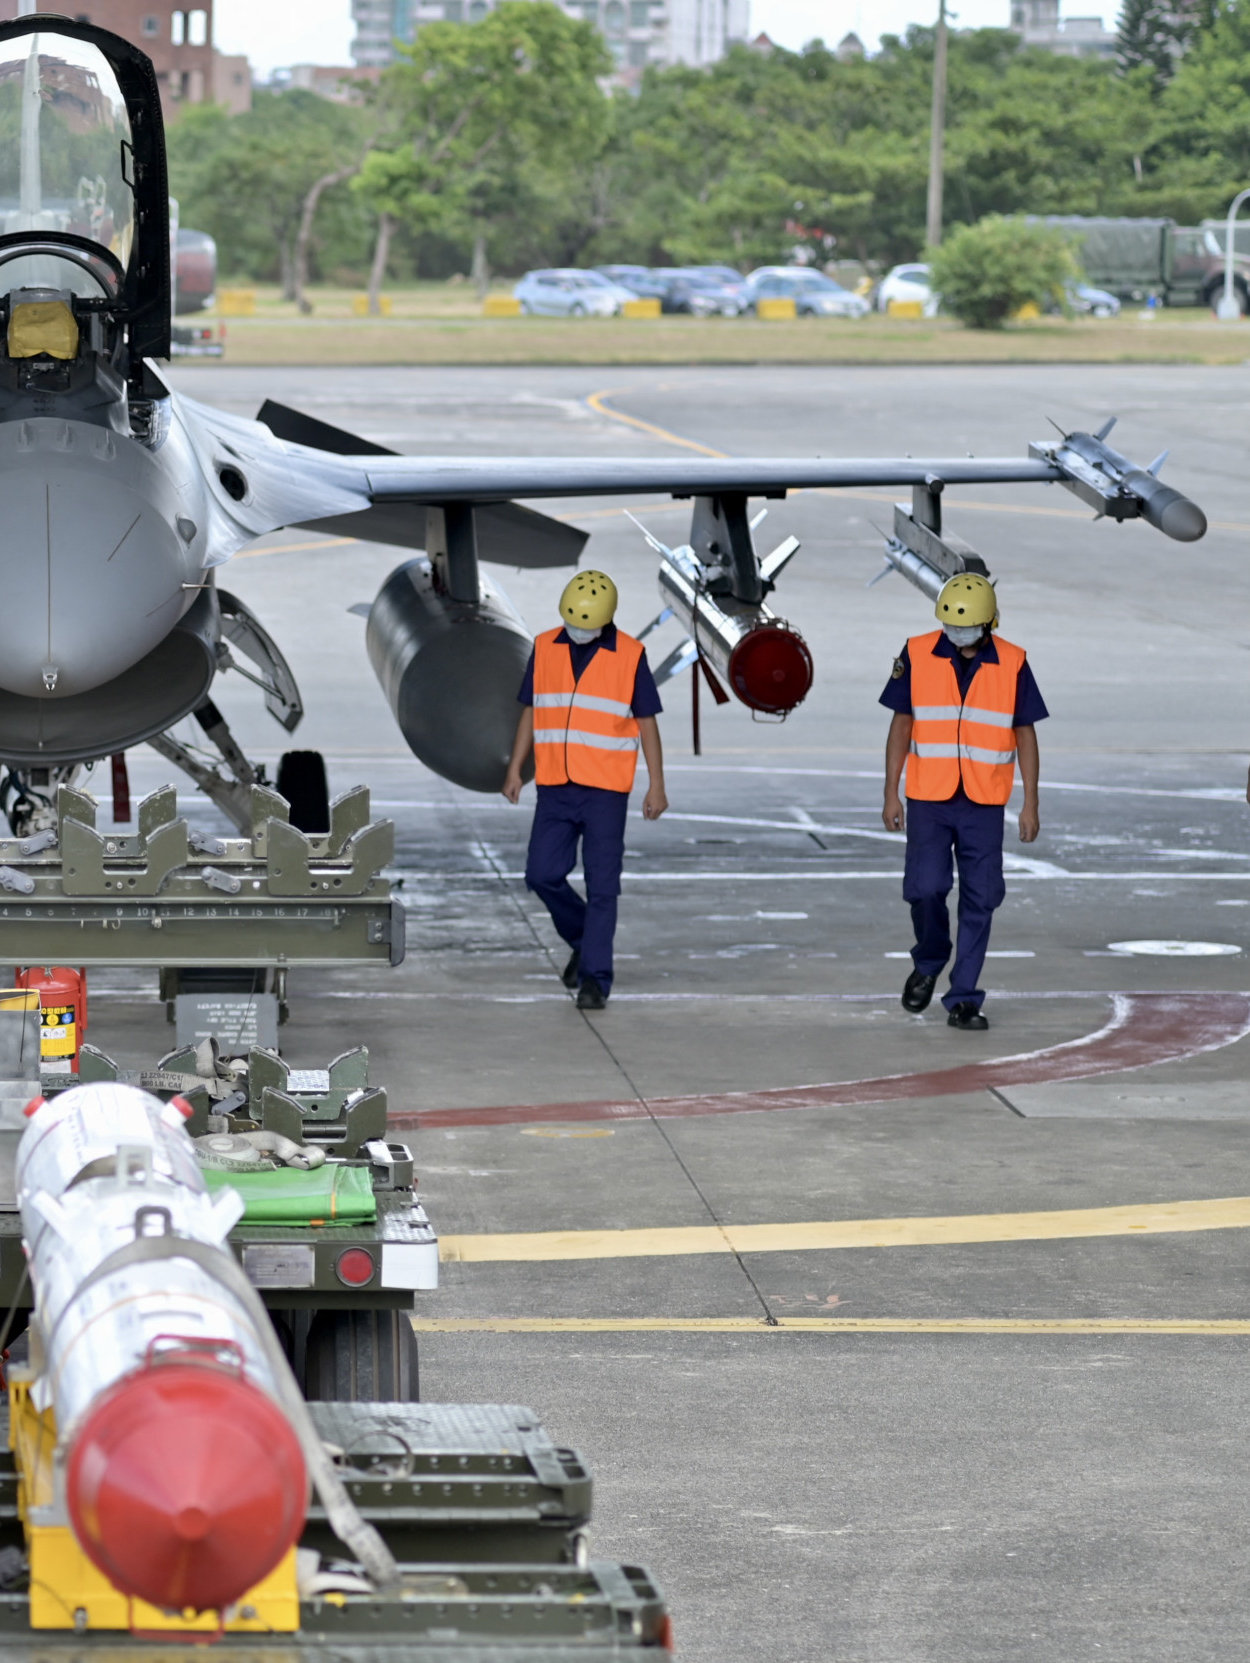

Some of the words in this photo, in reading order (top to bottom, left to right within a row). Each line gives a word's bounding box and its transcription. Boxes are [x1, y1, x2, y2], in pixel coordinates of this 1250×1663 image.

[2, 908, 8, 916] 4
[25, 908, 32, 916] 5
[116, 908, 122, 916] 9
[137, 908, 148, 916] 10
[183, 908, 194, 916] 12
[206, 908, 216, 916] 13
[229, 908, 239, 916] 14
[275, 908, 285, 916] 16
[297, 908, 308, 916] 17
